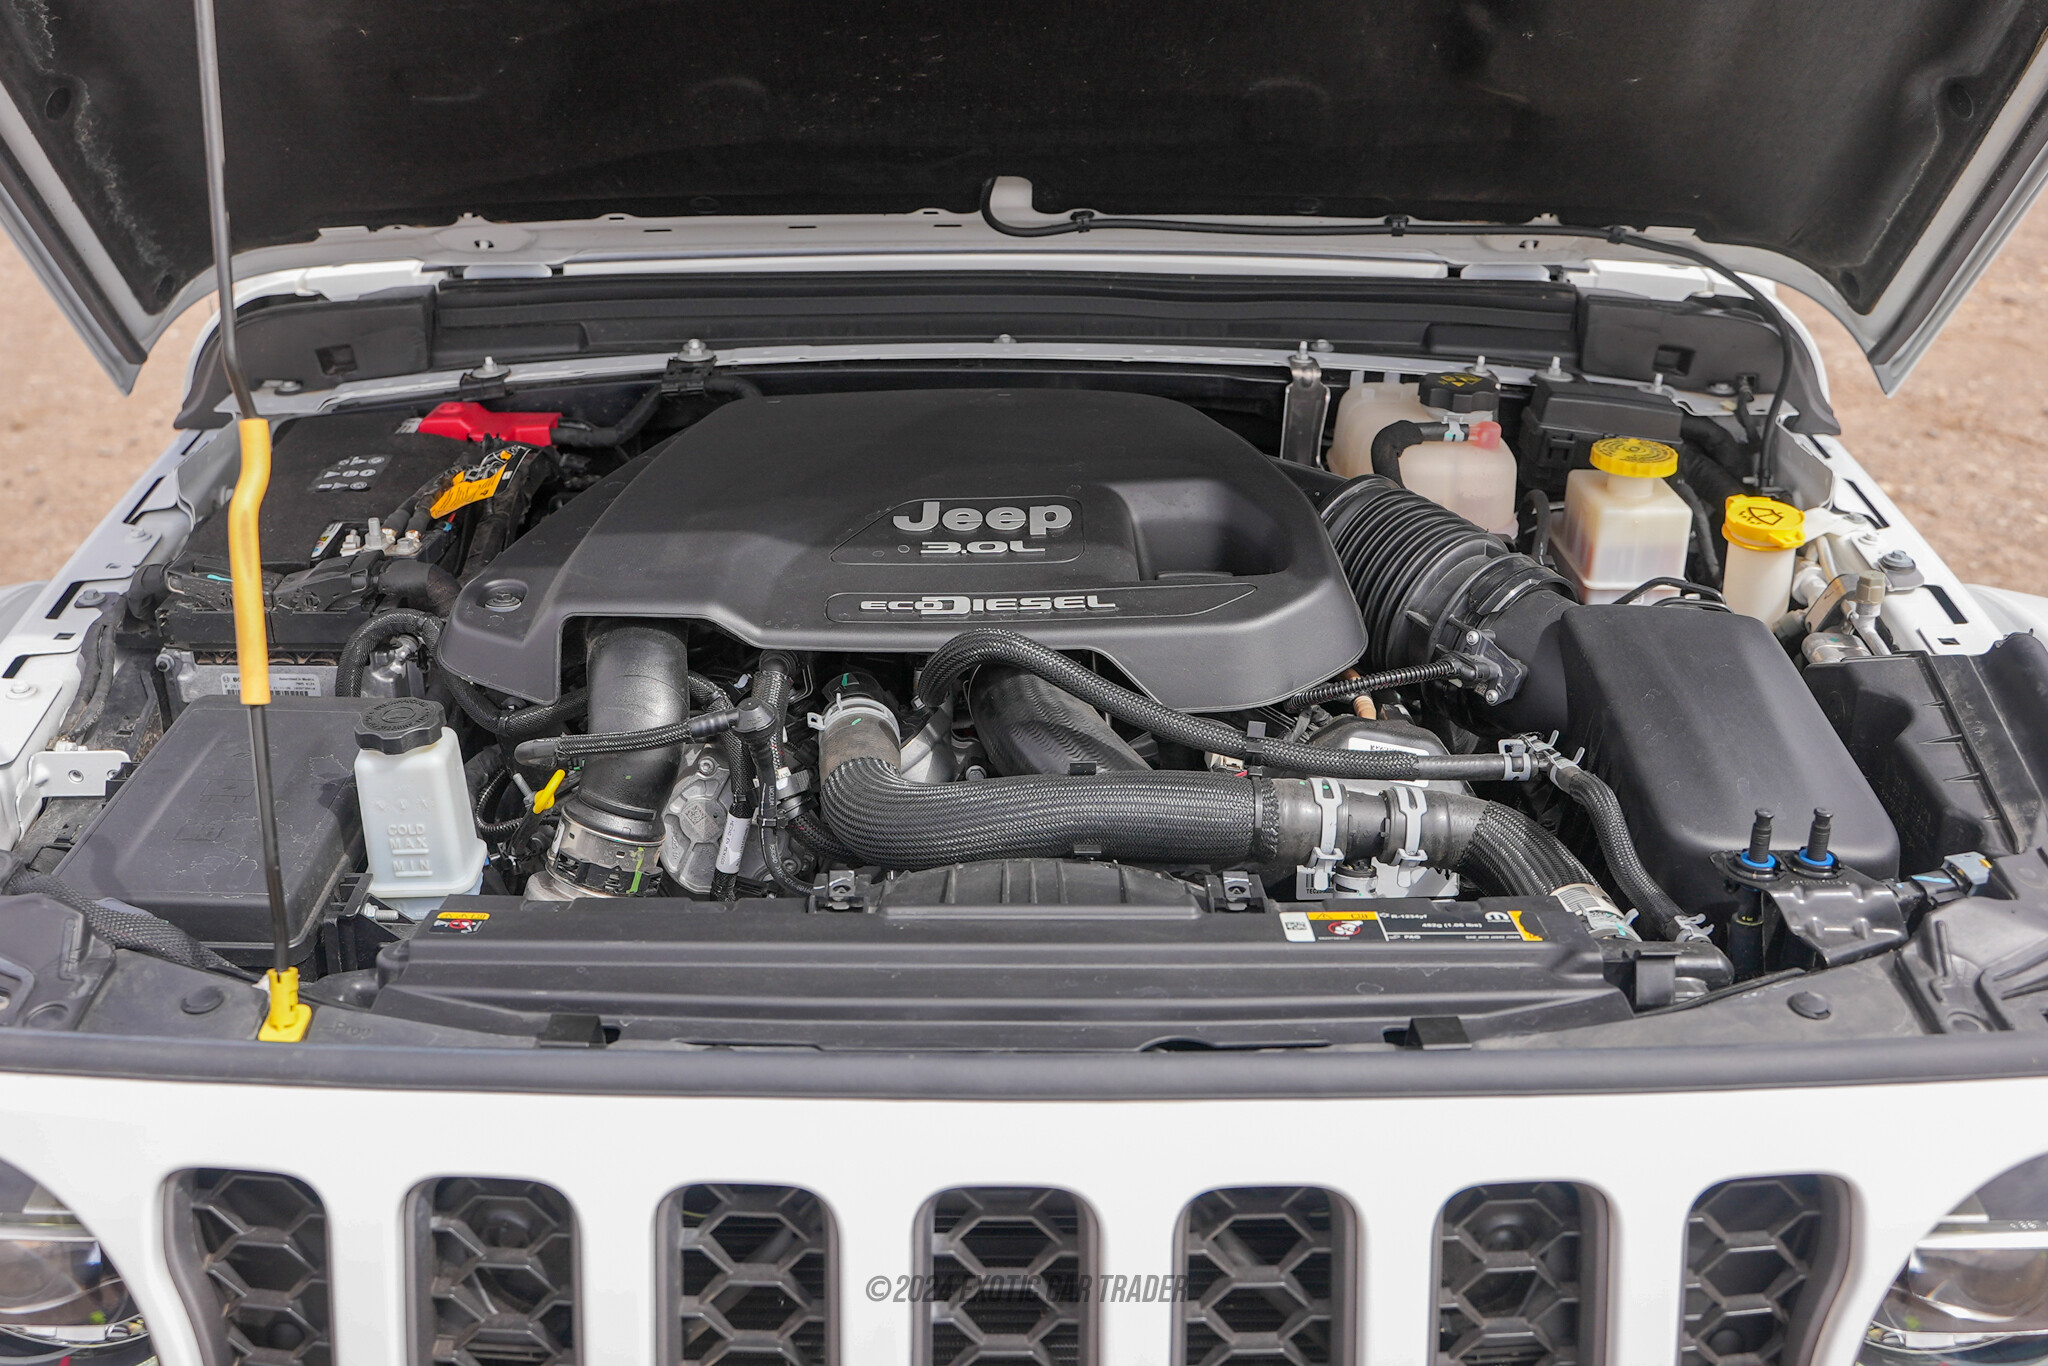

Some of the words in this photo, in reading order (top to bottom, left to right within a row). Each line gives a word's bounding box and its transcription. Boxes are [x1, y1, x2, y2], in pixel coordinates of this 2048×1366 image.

[892, 501, 1072, 536] Jeep
[920, 540, 1046, 554] 3.0L
[387, 823, 425, 836] COLD
[389, 836, 428, 849] MAX
[392, 859, 431, 871] MIN
